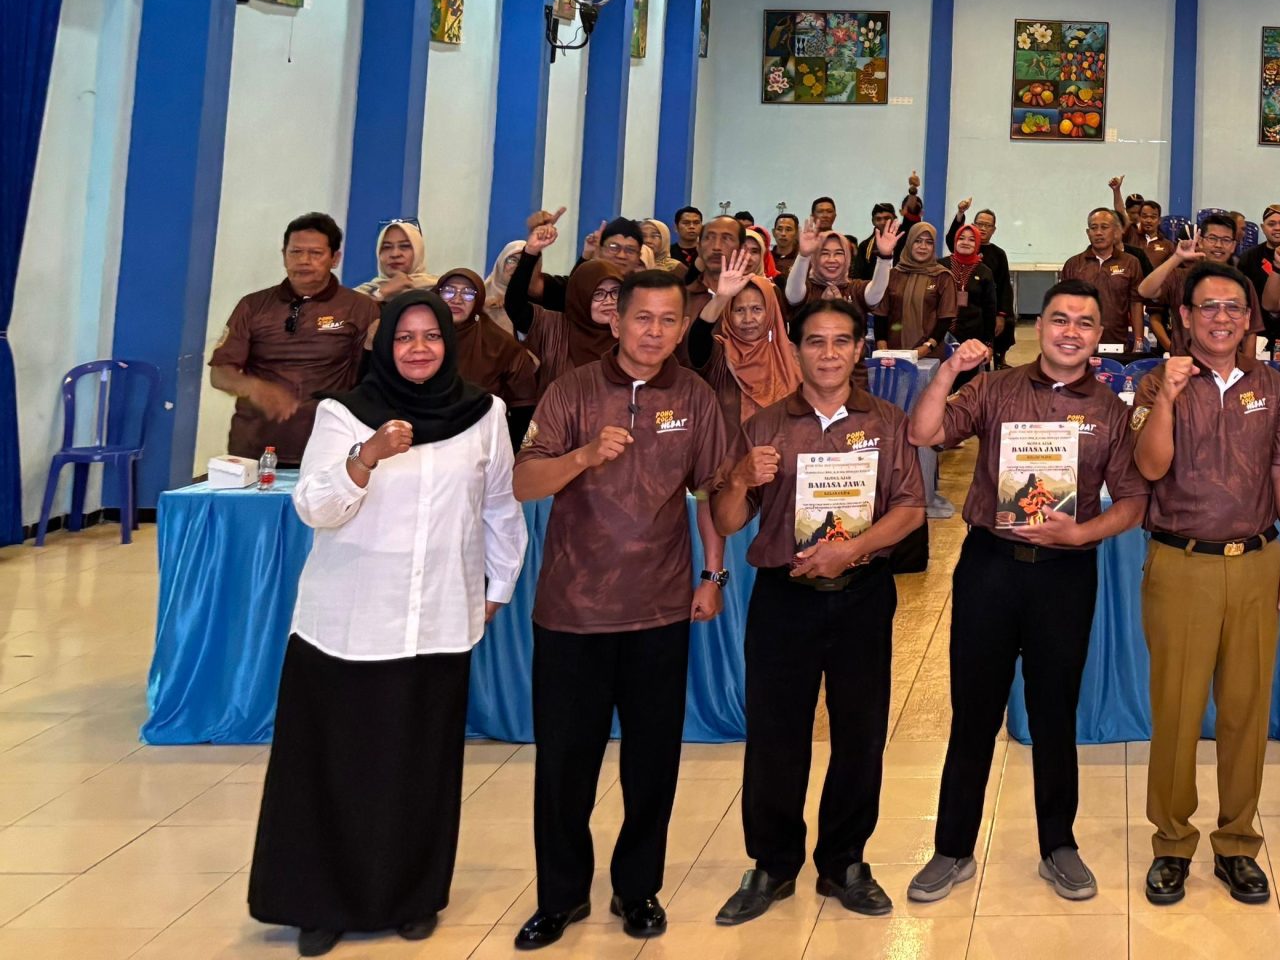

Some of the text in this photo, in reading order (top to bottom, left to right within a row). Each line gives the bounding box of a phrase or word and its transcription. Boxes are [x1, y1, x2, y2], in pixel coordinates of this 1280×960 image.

[655, 410, 674, 418] PONO
[660, 418, 688, 429] HEBAT
[852, 437, 880, 450] HEBAT
[808, 481, 841, 489] BAHASA
